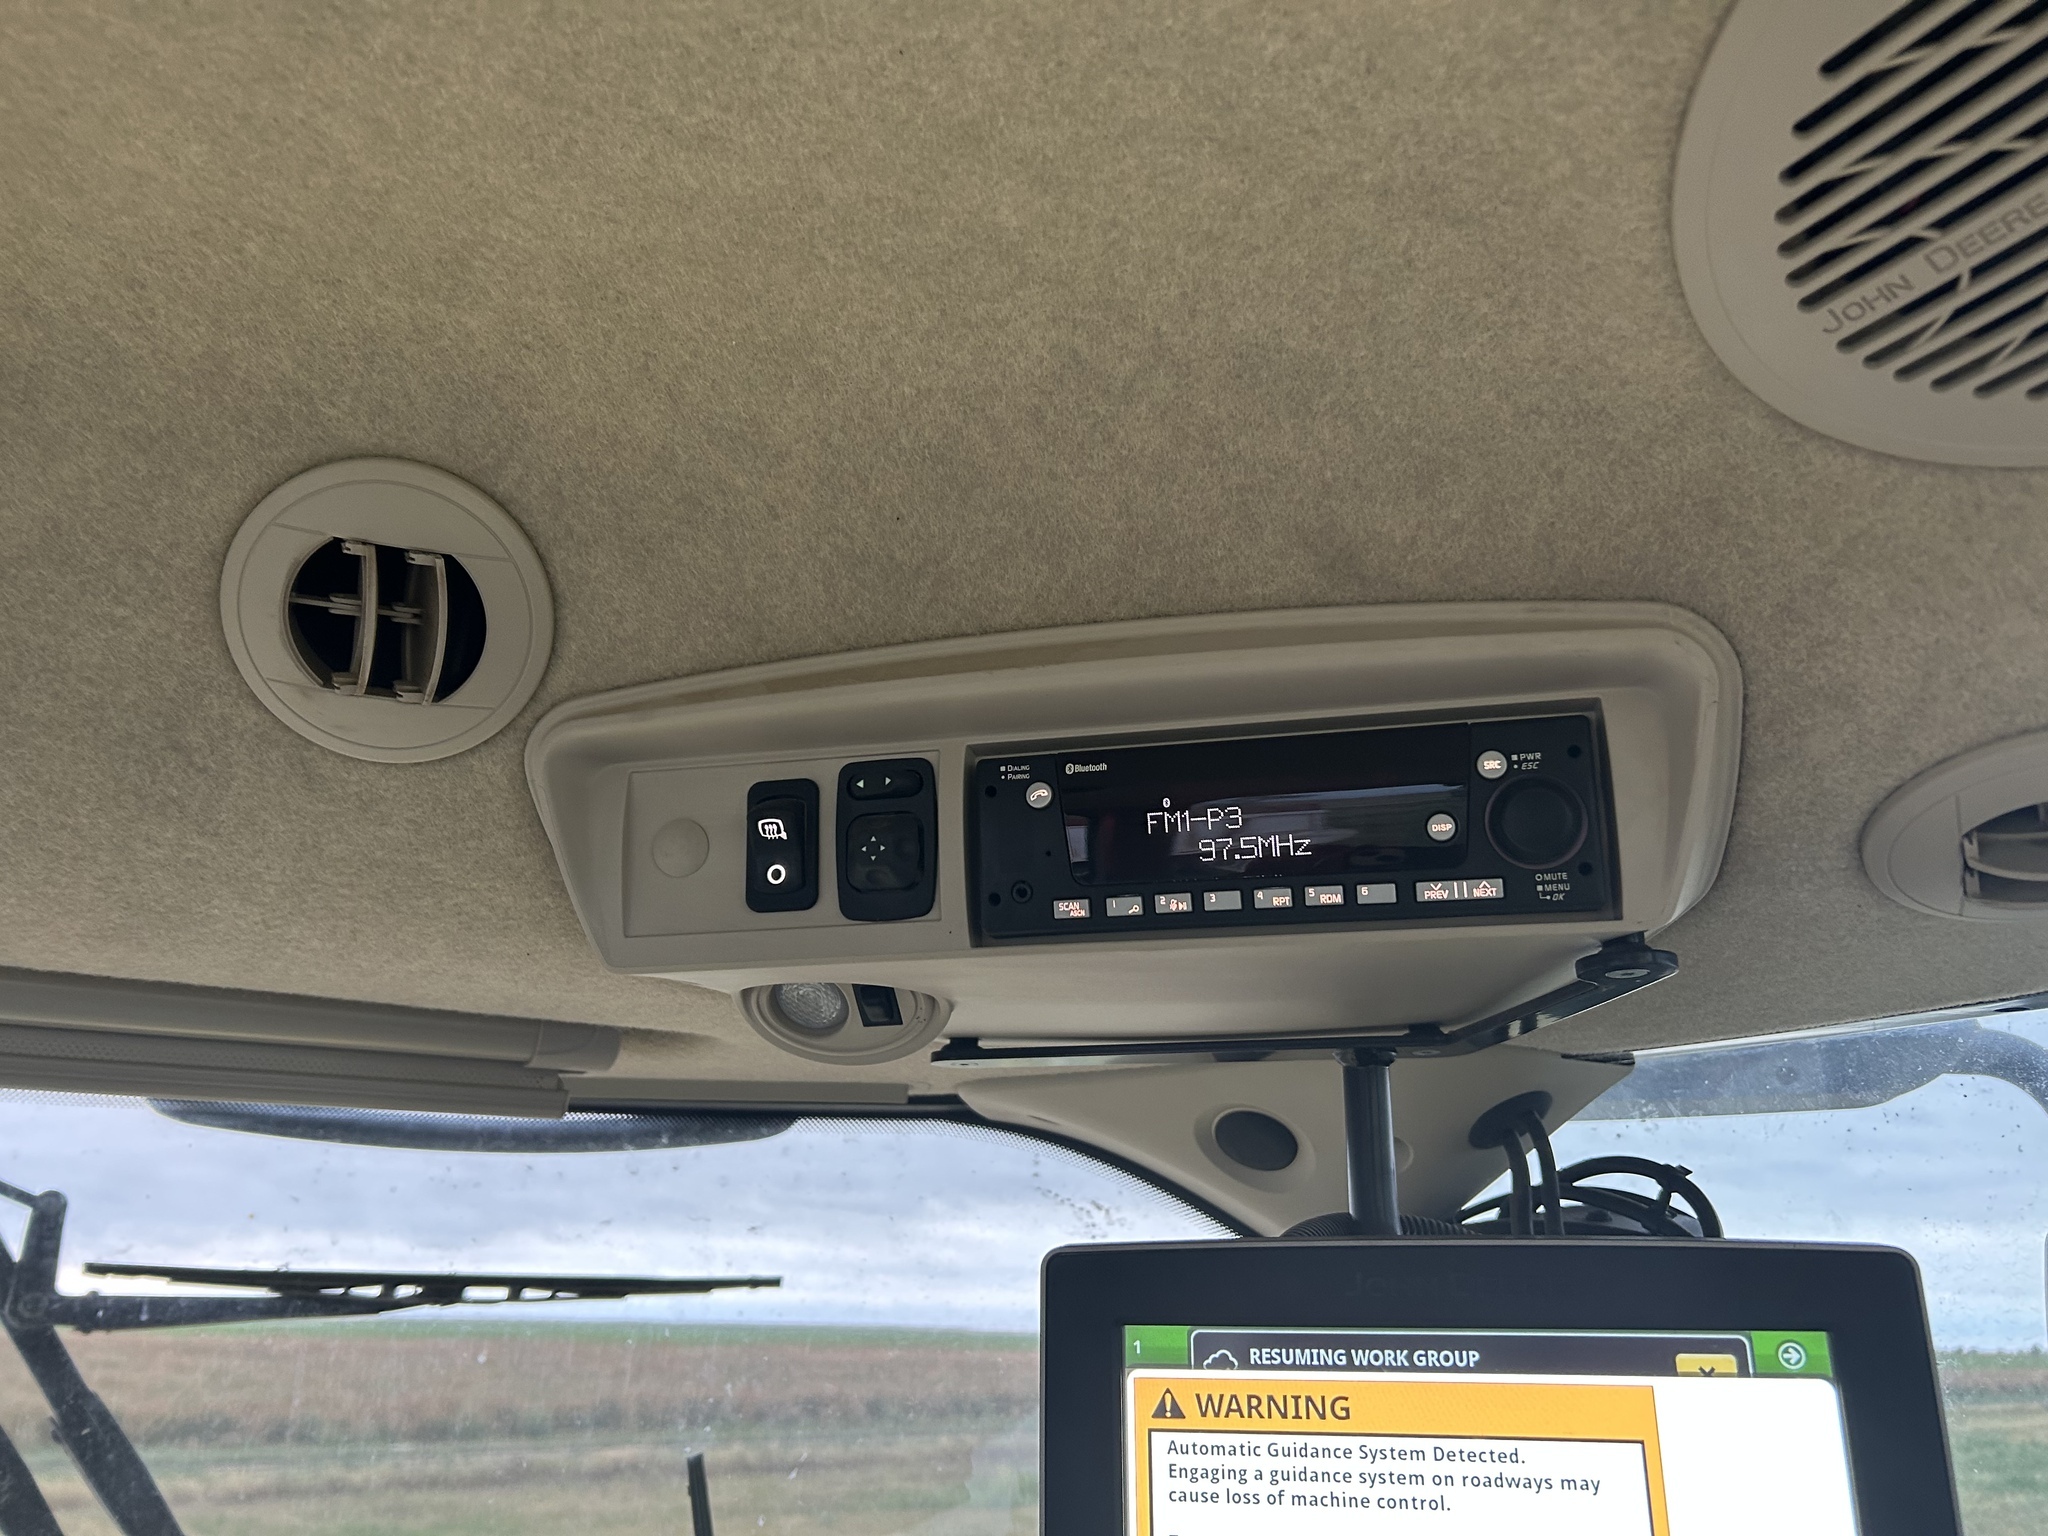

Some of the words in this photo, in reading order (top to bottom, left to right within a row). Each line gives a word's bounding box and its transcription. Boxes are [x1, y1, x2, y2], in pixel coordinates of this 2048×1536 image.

[1821, 273, 1916, 334] JOHN
[1922, 192, 2048, 275] DEERE
[1519, 752, 1542, 761] PWR
[1007, 764, 1030, 772] DIALING
[1074, 762, 1108, 773] Bluetooth
[1482, 760, 1502, 770] SRC
[1520, 761, 1540, 770] ESC
[1146, 806, 1243, 835] FM1-P3
[1431, 822, 1453, 833] DISP
[1198, 833, 1313, 862] 97.5MHz
[1543, 872, 1568, 881] MUTE
[1308, 888, 1315, 897] 5
[1361, 887, 1368, 896] 6
[1472, 887, 1498, 898] NEXT
[1544, 883, 1571, 892] MENU
[1209, 893, 1216, 902] 3
[1256, 891, 1264, 900] 4
[1319, 893, 1342, 904] RDM
[1423, 889, 1450, 900] PREV
[1552, 893, 1565, 901] OK
[1159, 896, 1166, 905] 2
[1272, 896, 1290, 906] RPT
[1058, 901, 1080, 911] SCAN
[1133, 1340, 1142, 1354] 1
[1249, 1348, 1347, 1366] RESUMING
[1351, 1349, 1408, 1367] WORK
[1412, 1350, 1480, 1368] GROUP
[1194, 1391, 1351, 1421] WARNING
[1167, 1440, 1262, 1457] Automatic
[1267, 1442, 1353, 1460] Guidance
[1359, 1445, 1426, 1464] System
[1433, 1446, 1526, 1464] Detected.
[1168, 1463, 1248, 1484] Engaging
[1254, 1469, 1263, 1481] a
[1269, 1466, 1353, 1486] guidance
[1359, 1470, 1425, 1489] system
[1432, 1474, 1455, 1487] on
[1462, 1472, 1554, 1494] roadways
[1560, 1478, 1601, 1496] may
[1168, 1489, 1220, 1504] cause
[1226, 1488, 1261, 1505] loss
[1267, 1489, 1286, 1506] of
[1291, 1491, 1371, 1509] machine
[1377, 1495, 1451, 1512] control.
